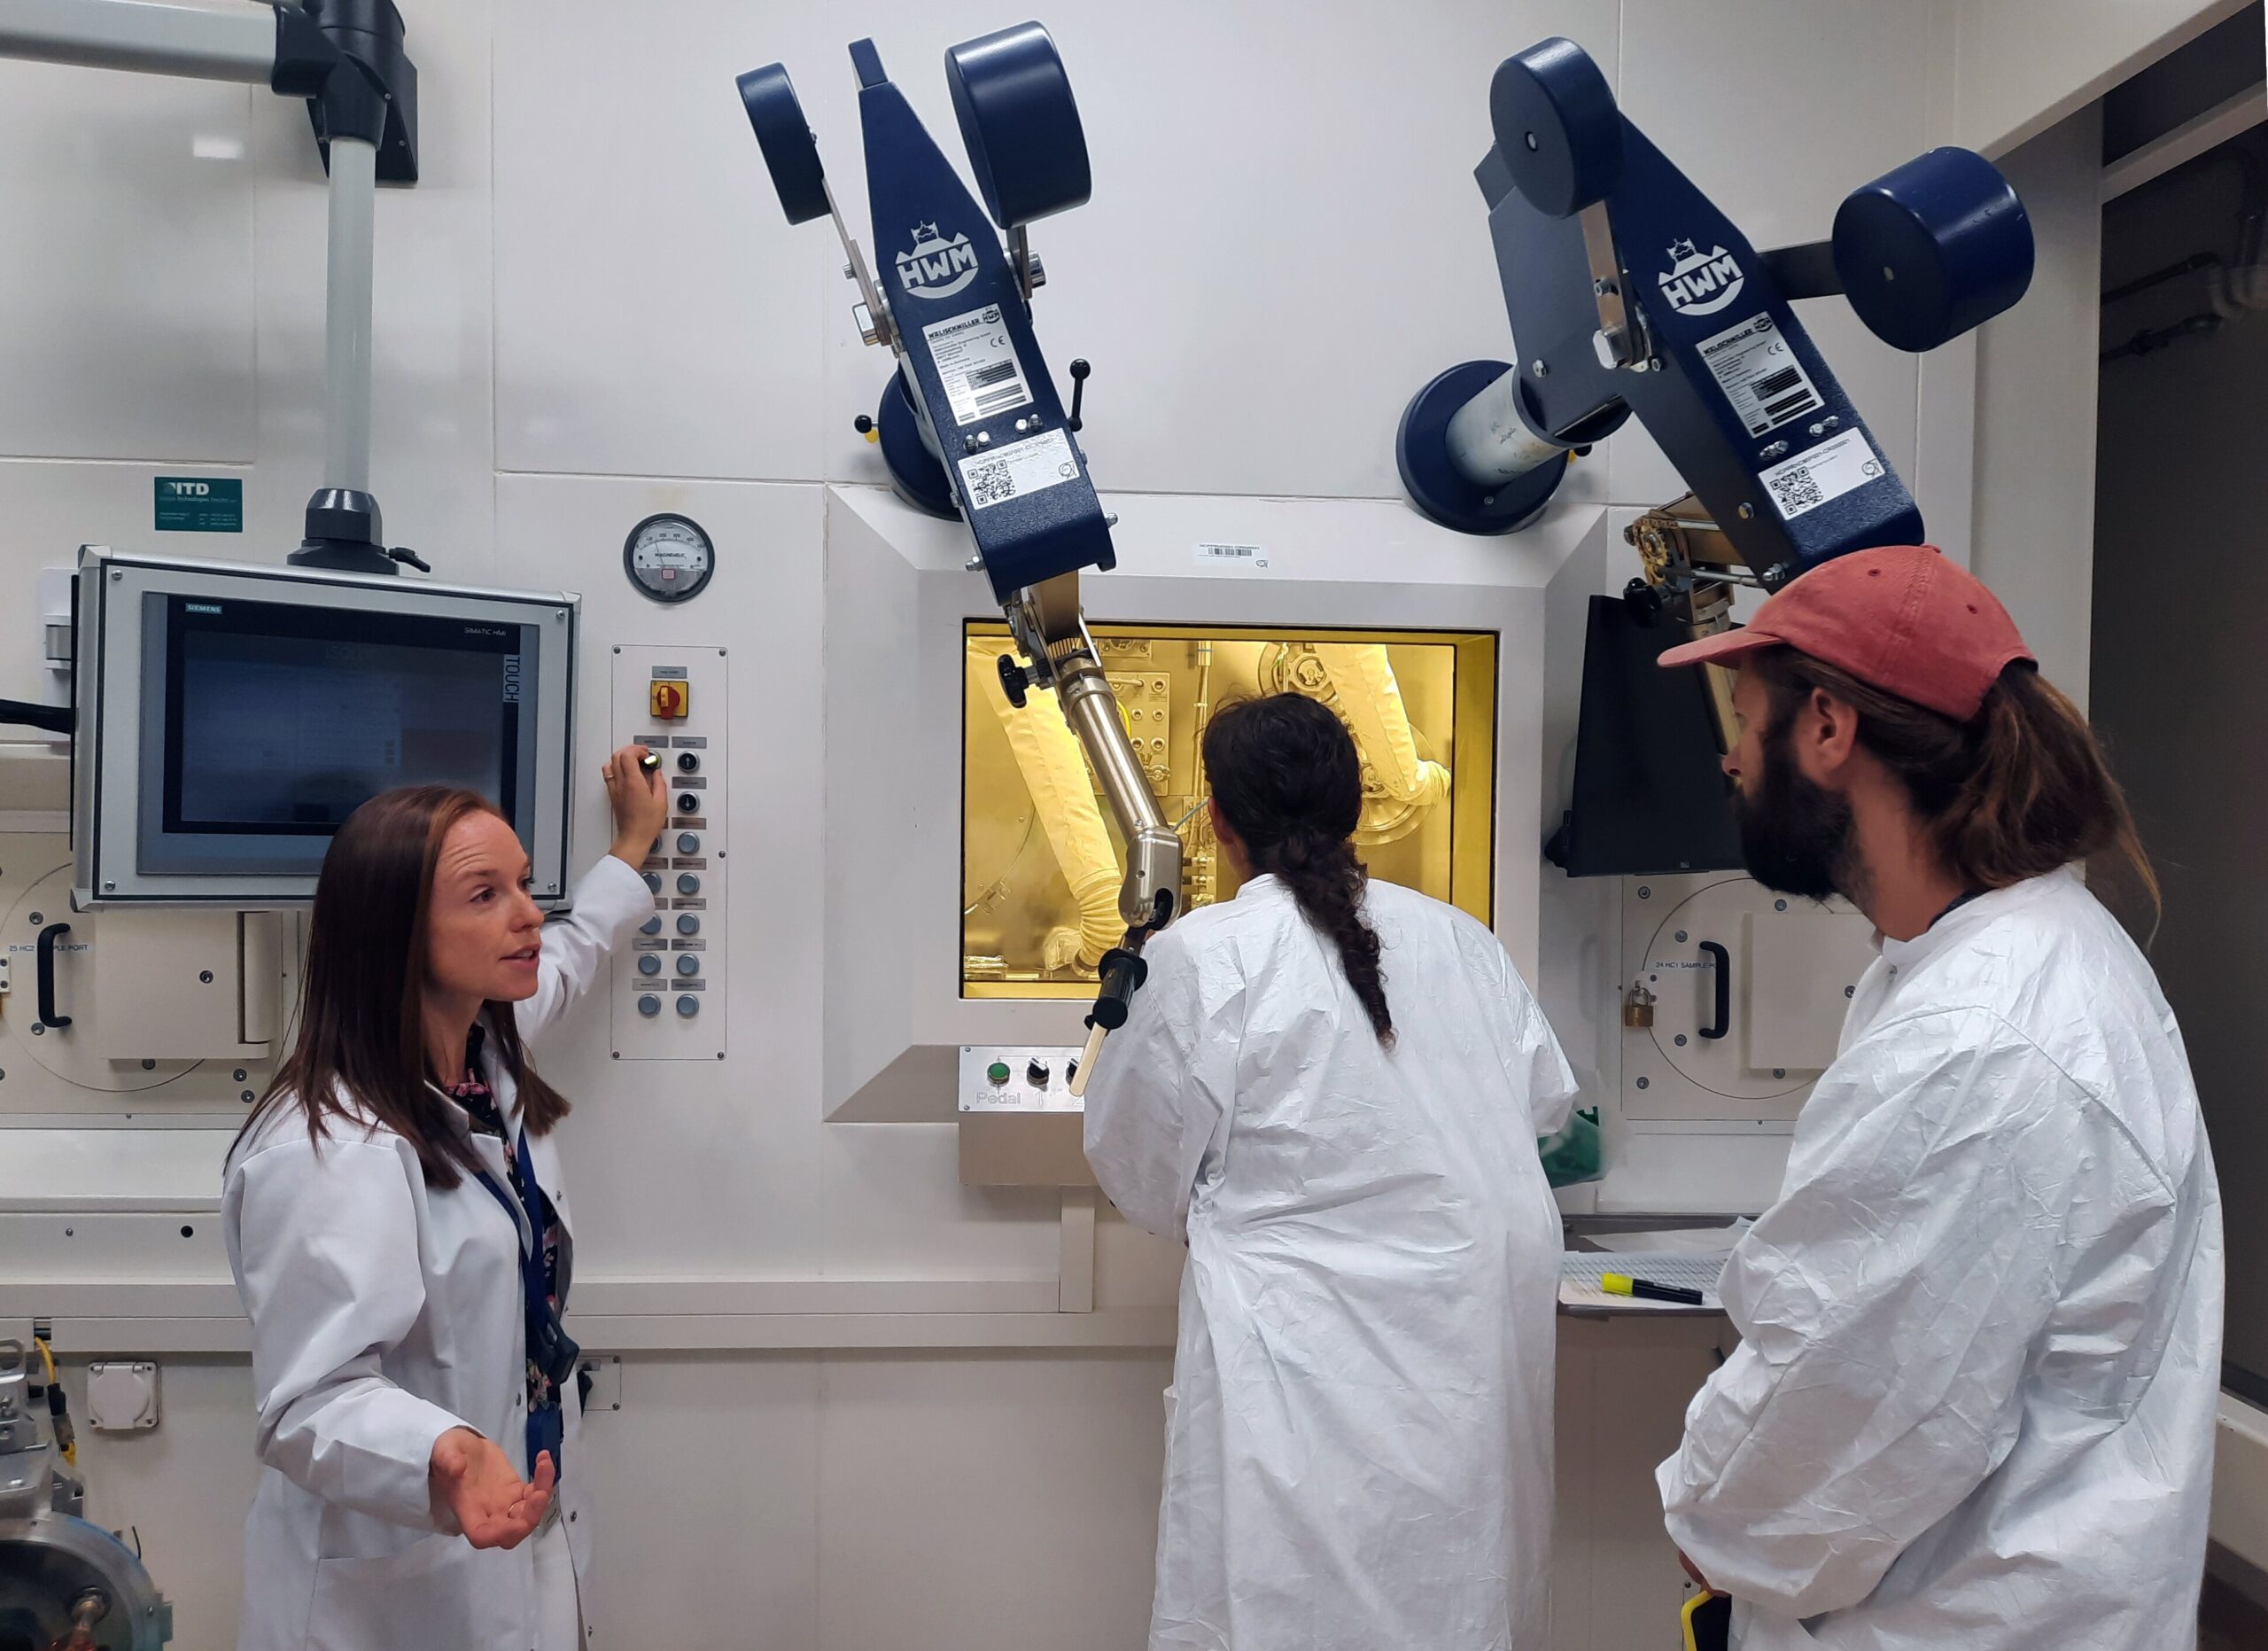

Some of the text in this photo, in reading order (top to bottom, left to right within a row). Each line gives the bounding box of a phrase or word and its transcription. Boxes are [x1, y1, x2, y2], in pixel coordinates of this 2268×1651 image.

[897, 243, 979, 289] HWM
[1661, 254, 1744, 309] HWM
[176, 482, 209, 495] ITD
[187, 604, 221, 613] SIEMENS
[463, 627, 492, 635] SIMATIC
[505, 657, 520, 702] TOUCH
[976, 1092, 1021, 1104] Pedal
